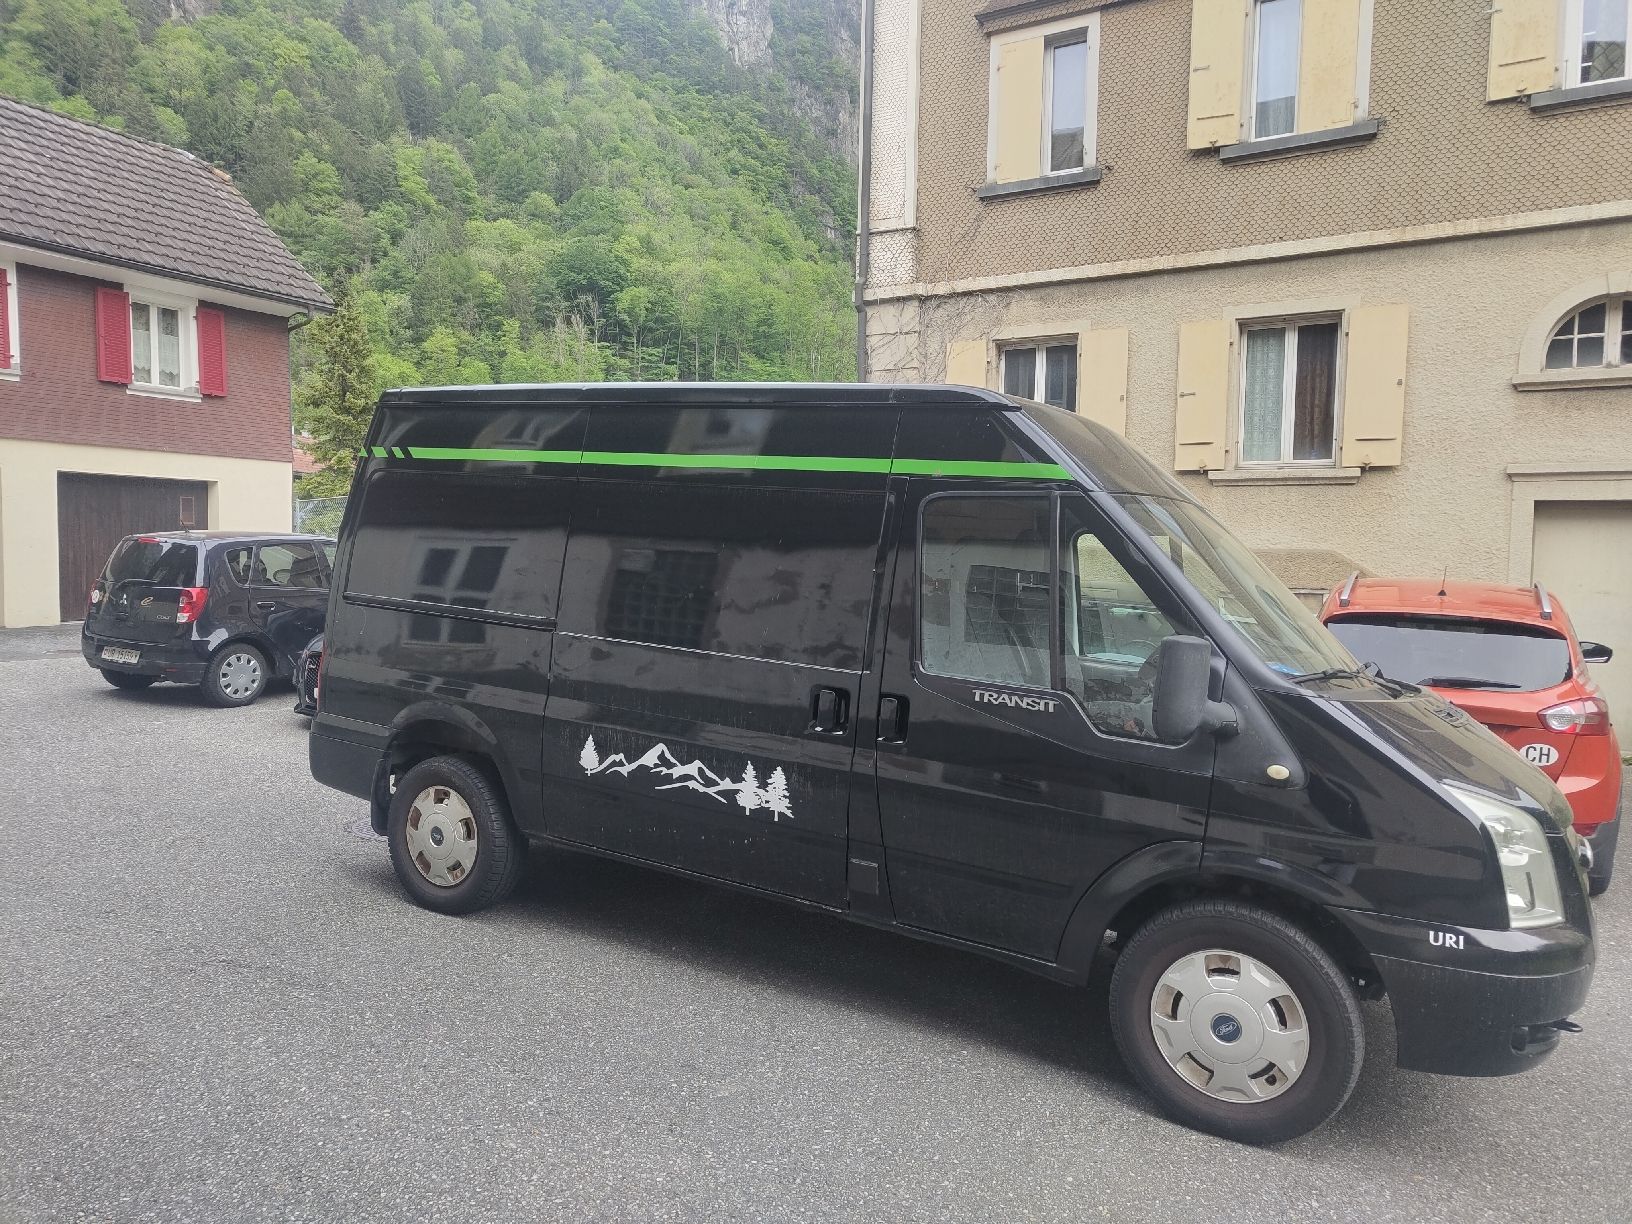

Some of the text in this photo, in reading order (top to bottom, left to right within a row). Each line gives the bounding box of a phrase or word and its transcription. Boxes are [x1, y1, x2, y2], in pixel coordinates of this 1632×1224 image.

[972, 689, 1060, 713] TRANSIT
[1525, 745, 1551, 764] CH
[1429, 930, 1464, 950] URI
